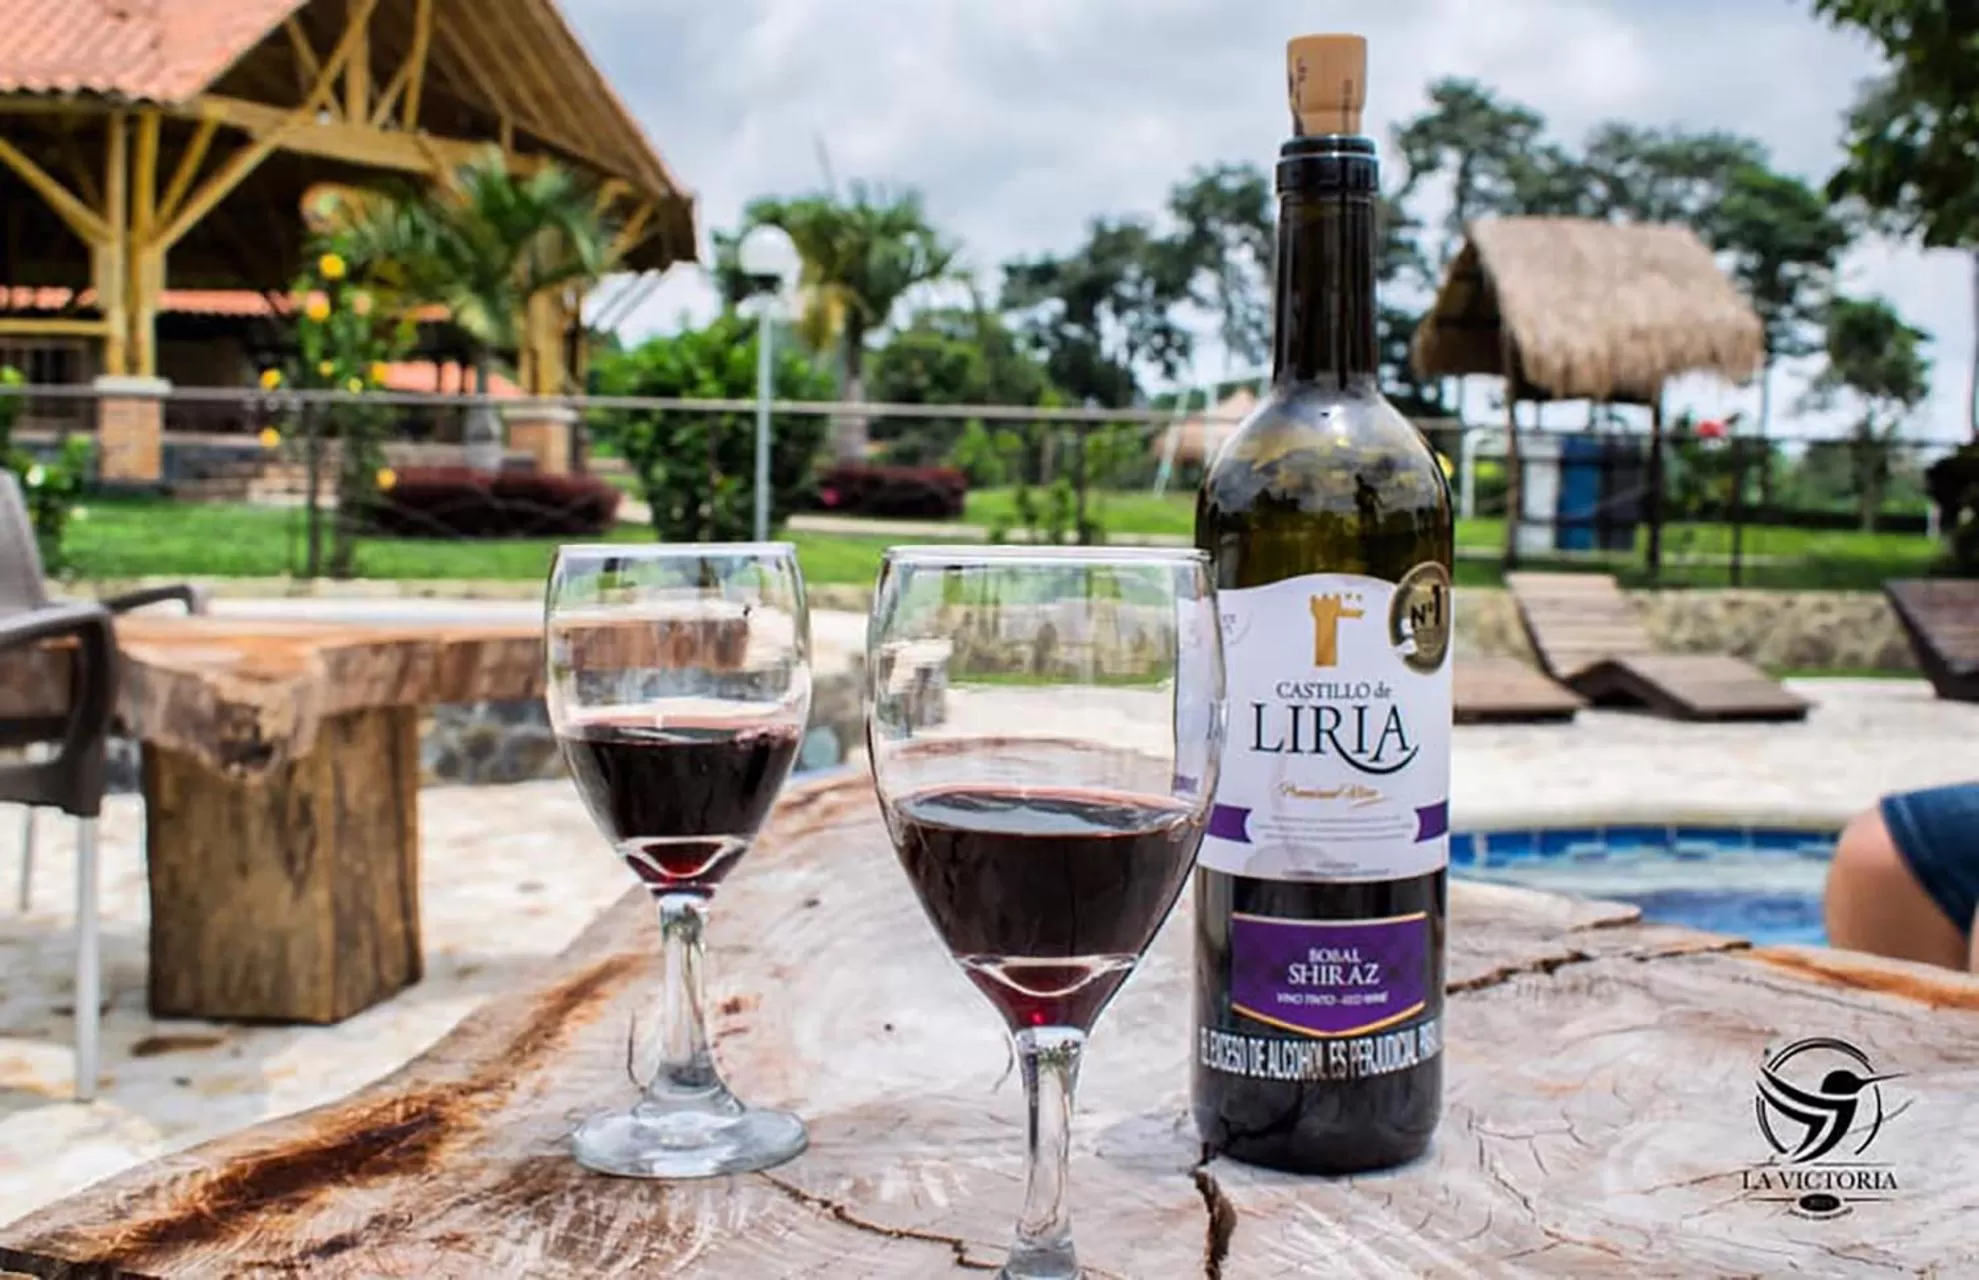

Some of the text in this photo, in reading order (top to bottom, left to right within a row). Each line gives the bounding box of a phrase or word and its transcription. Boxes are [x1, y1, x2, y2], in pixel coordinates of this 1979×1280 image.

[1276, 681, 1392, 699] CASTILLO de
[1250, 702, 1419, 775] LIRIA
[1308, 947, 1361, 963] BOBAL
[1288, 962, 1380, 986] SHIRAZ
[1249, 1037, 1266, 1078] DE
[1267, 1039, 1328, 1081] ALCOHOL
[1329, 1040, 1347, 1079] ES
